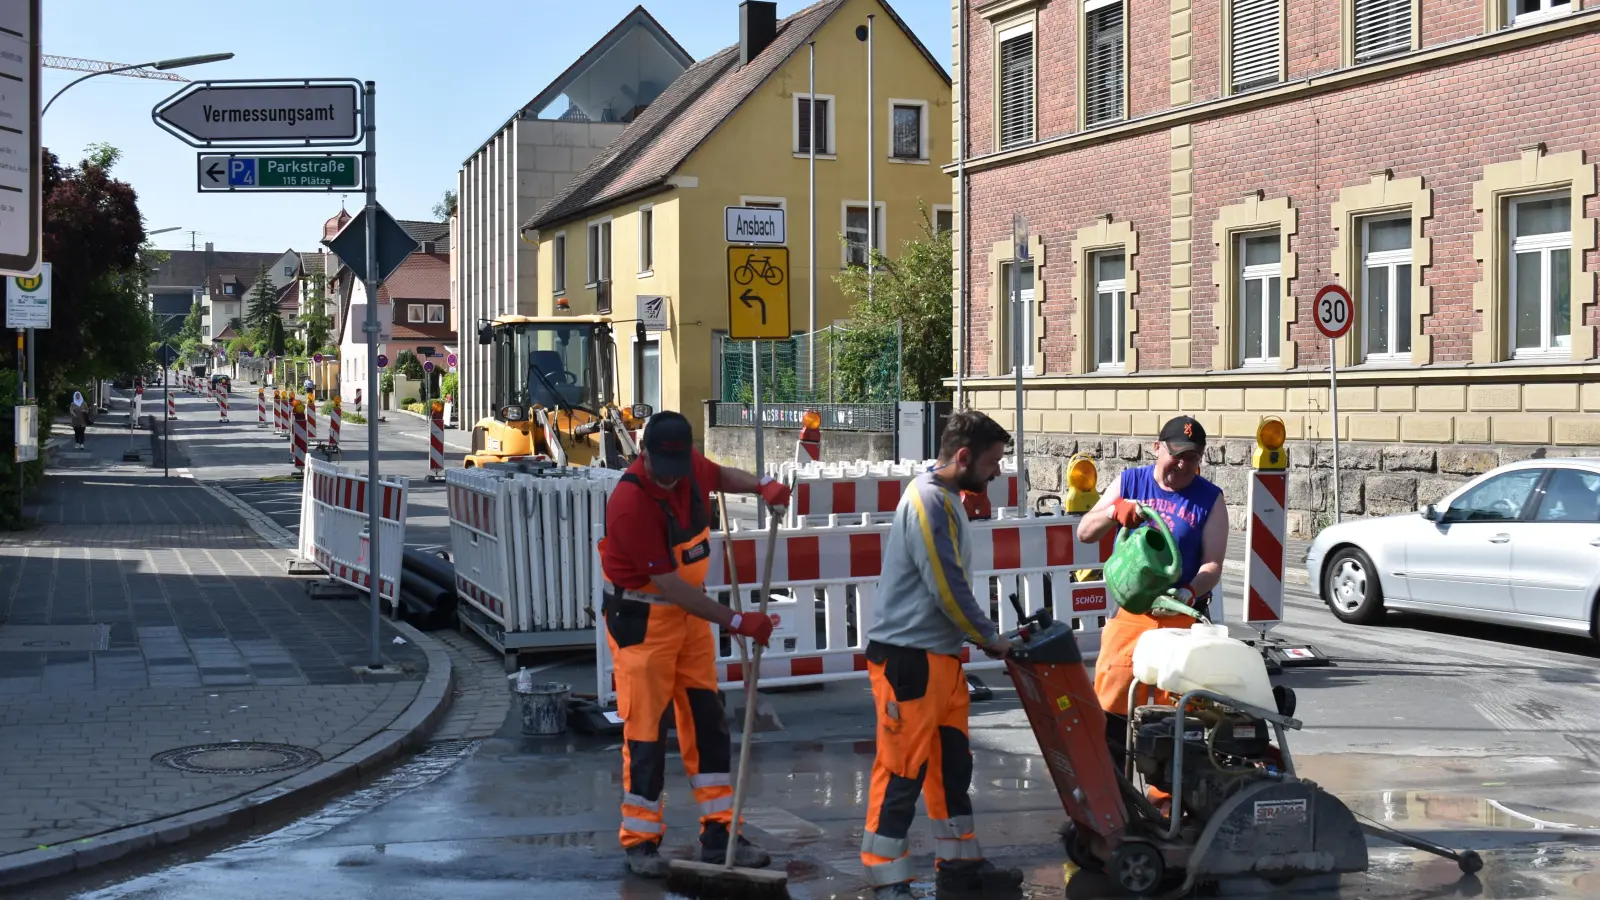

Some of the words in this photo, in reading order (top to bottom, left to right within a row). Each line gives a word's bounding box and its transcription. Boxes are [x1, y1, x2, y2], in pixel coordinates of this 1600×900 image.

[203, 104, 334, 126] Vermessungsamt
[267, 160, 345, 173] Parkstraße
[283, 176, 297, 185] 115
[300, 176, 331, 185] Plätze
[736, 214, 775, 236] Ansbach
[1321, 299, 1345, 324] 30
[1075, 594, 1104, 605] SCHÖTZ
